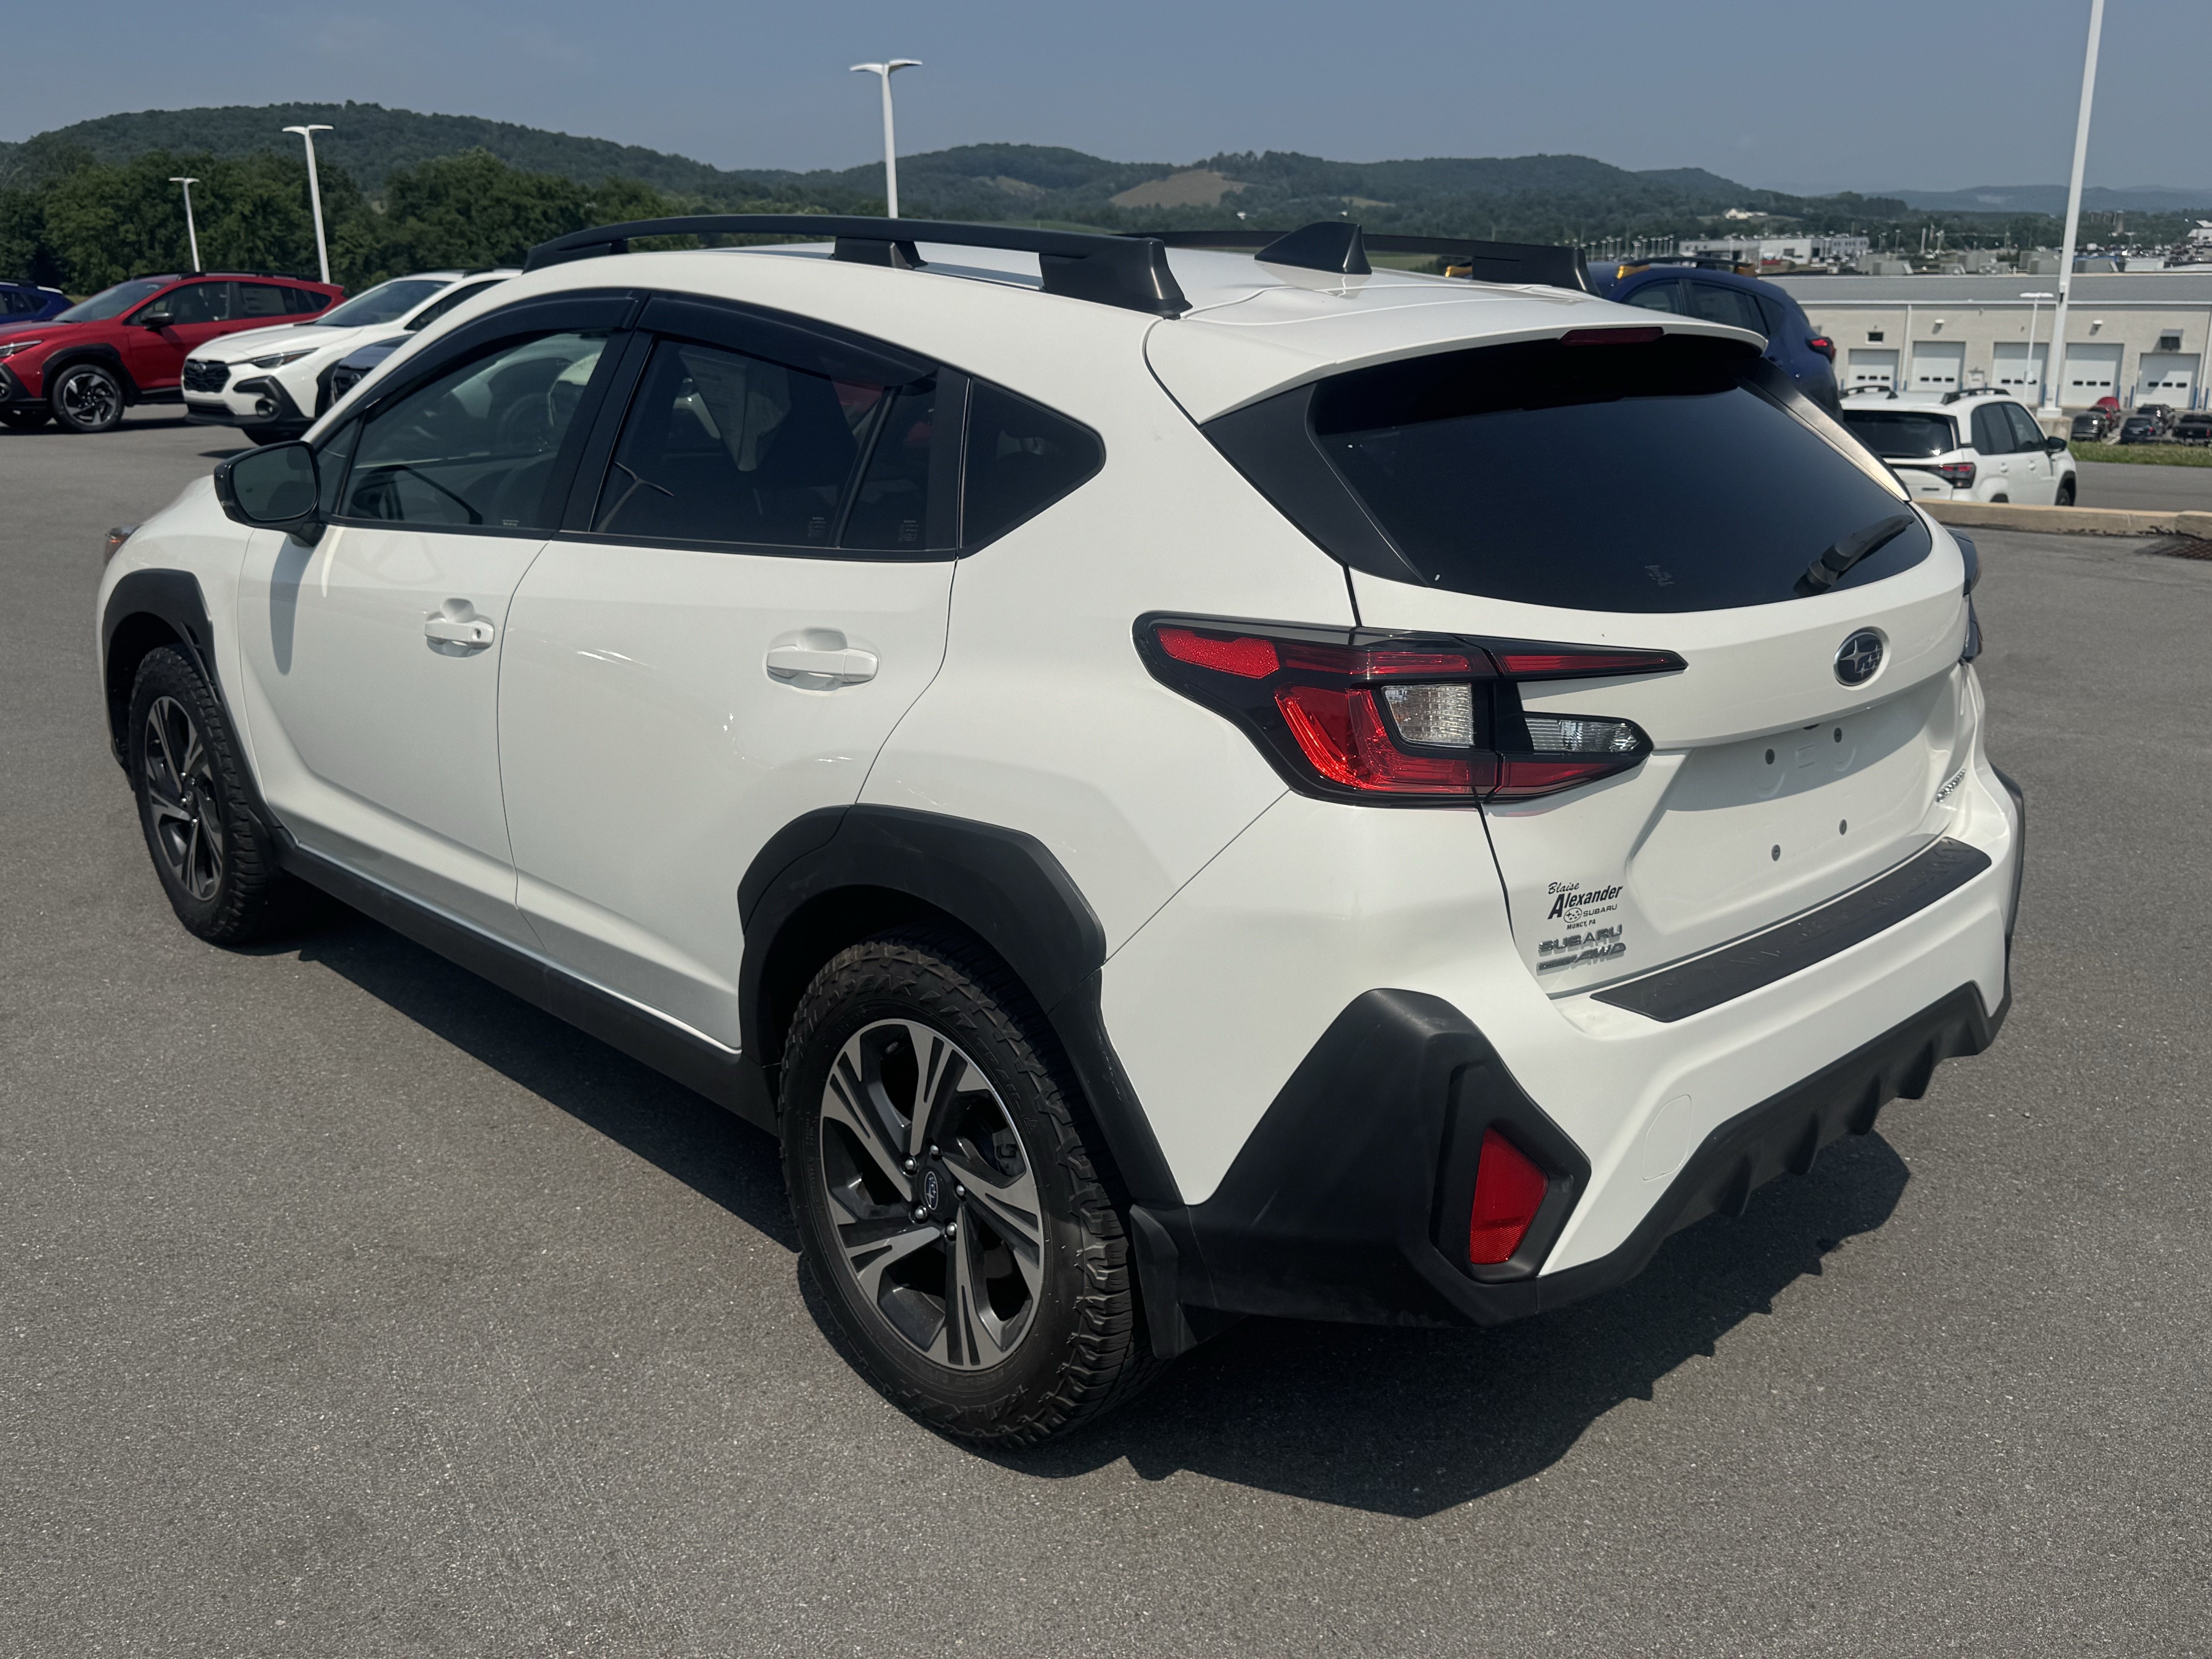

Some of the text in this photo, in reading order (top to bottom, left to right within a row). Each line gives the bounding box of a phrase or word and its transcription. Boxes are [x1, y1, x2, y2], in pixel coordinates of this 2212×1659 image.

[1548, 881, 1580, 894] Blaise
[1547, 885, 1623, 920] Alexander
[1583, 904, 1617, 917] SUBARU
[1566, 921, 1587, 930] MUNCY,
[1539, 924, 1623, 952] SUBARU
